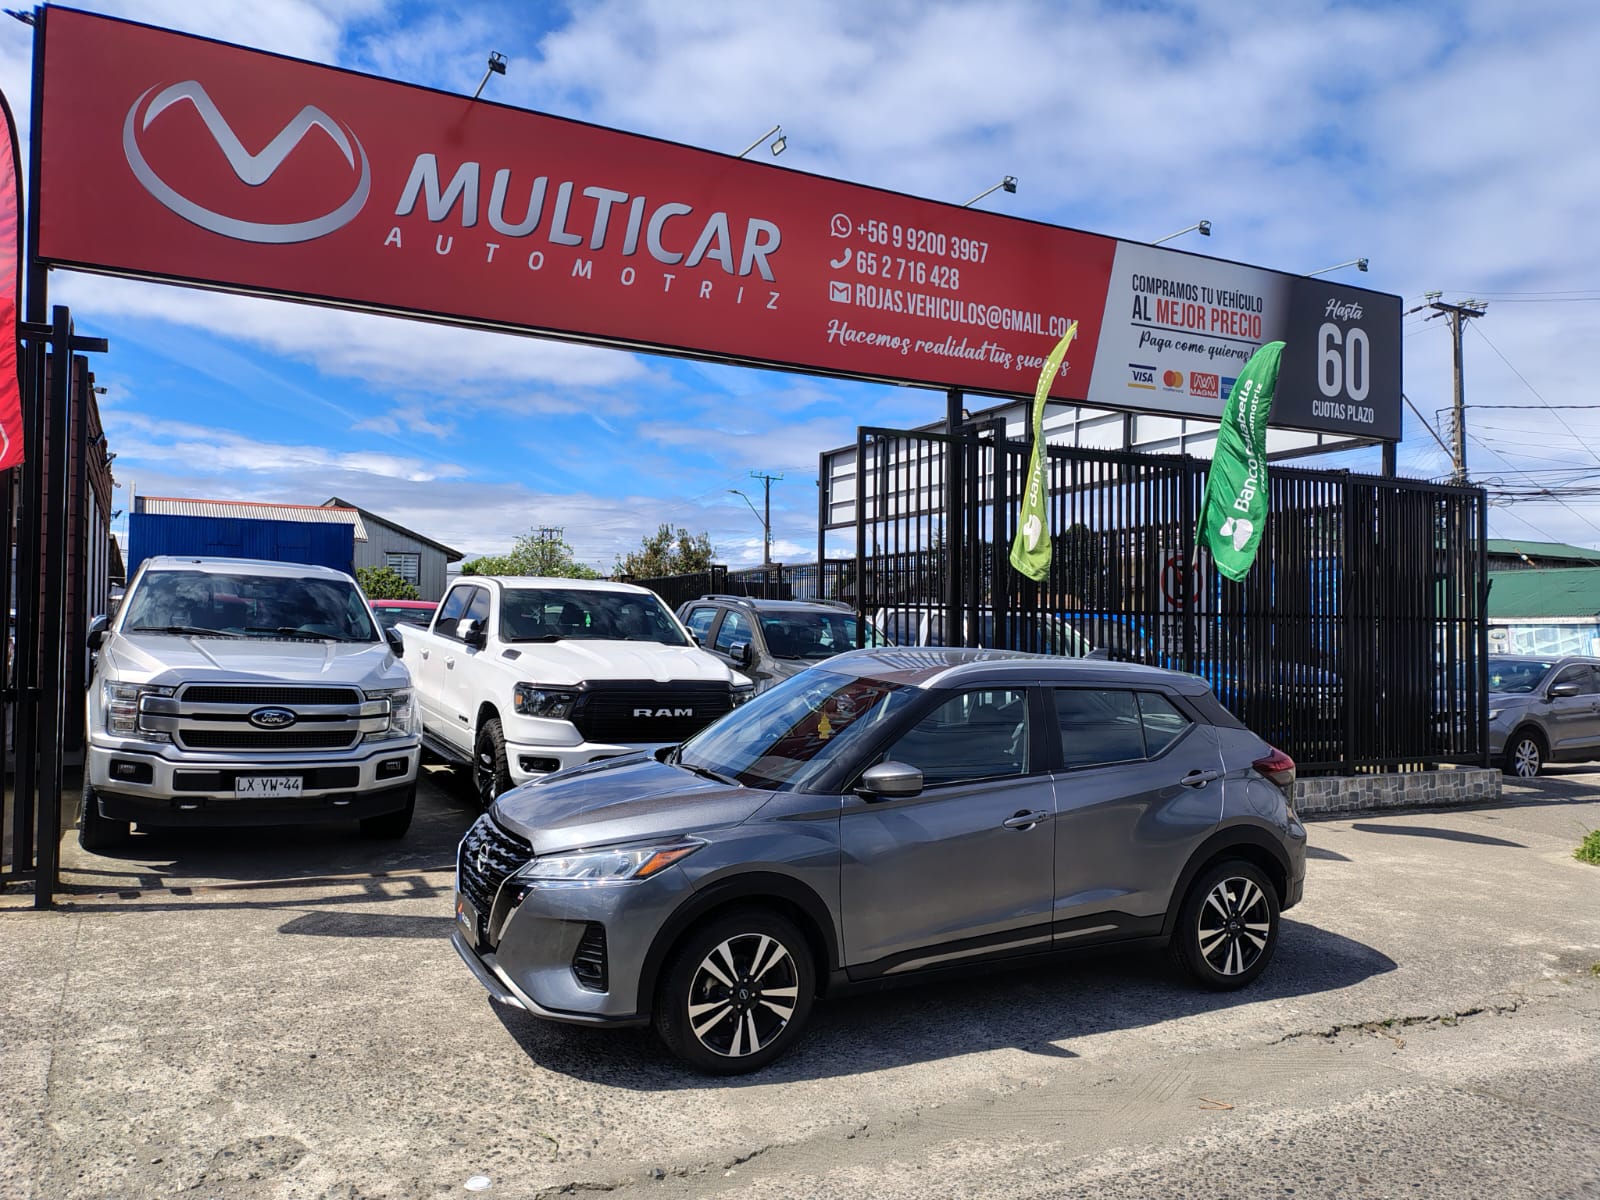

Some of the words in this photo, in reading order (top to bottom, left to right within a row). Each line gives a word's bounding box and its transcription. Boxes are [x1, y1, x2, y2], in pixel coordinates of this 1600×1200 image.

[395, 153, 782, 282] MULTICAR
[857, 219, 888, 245] +56
[893, 225, 902, 248] 9
[907, 228, 947, 256] 9200
[950, 236, 989, 263] 3967
[384, 226, 780, 310] AUTOMOTRIZ
[856, 251, 877, 276] 65
[882, 256, 892, 279] 2
[896, 258, 926, 284] 716
[930, 265, 960, 290] 428
[1132, 273, 1199, 302] COMPRAMOS
[1201, 286, 1214, 305] TU
[1216, 289, 1263, 313] VEHÍCULO
[1325, 298, 1363, 321] Hasta
[1132, 294, 1152, 322] AL
[1156, 298, 1206, 331] MEJOR
[1211, 307, 1262, 339] PRECIO
[827, 319, 912, 355] Hacemos
[914, 335, 987, 361] realidad
[983, 341, 1014, 370] tus
[1015, 354, 1072, 377] sues
[1138, 330, 1173, 352] Paga
[1175, 340, 1206, 354] como
[1318, 322, 1370, 401] 60
[1132, 370, 1154, 383] VISA
[1190, 388, 1218, 398] MAGNA
[1312, 400, 1345, 420] CUOTAS
[1347, 405, 1374, 424] PLAZO
[1233, 459, 1258, 513] Banco
[261, 712, 285, 722] Ford
[633, 708, 693, 717] RAM
